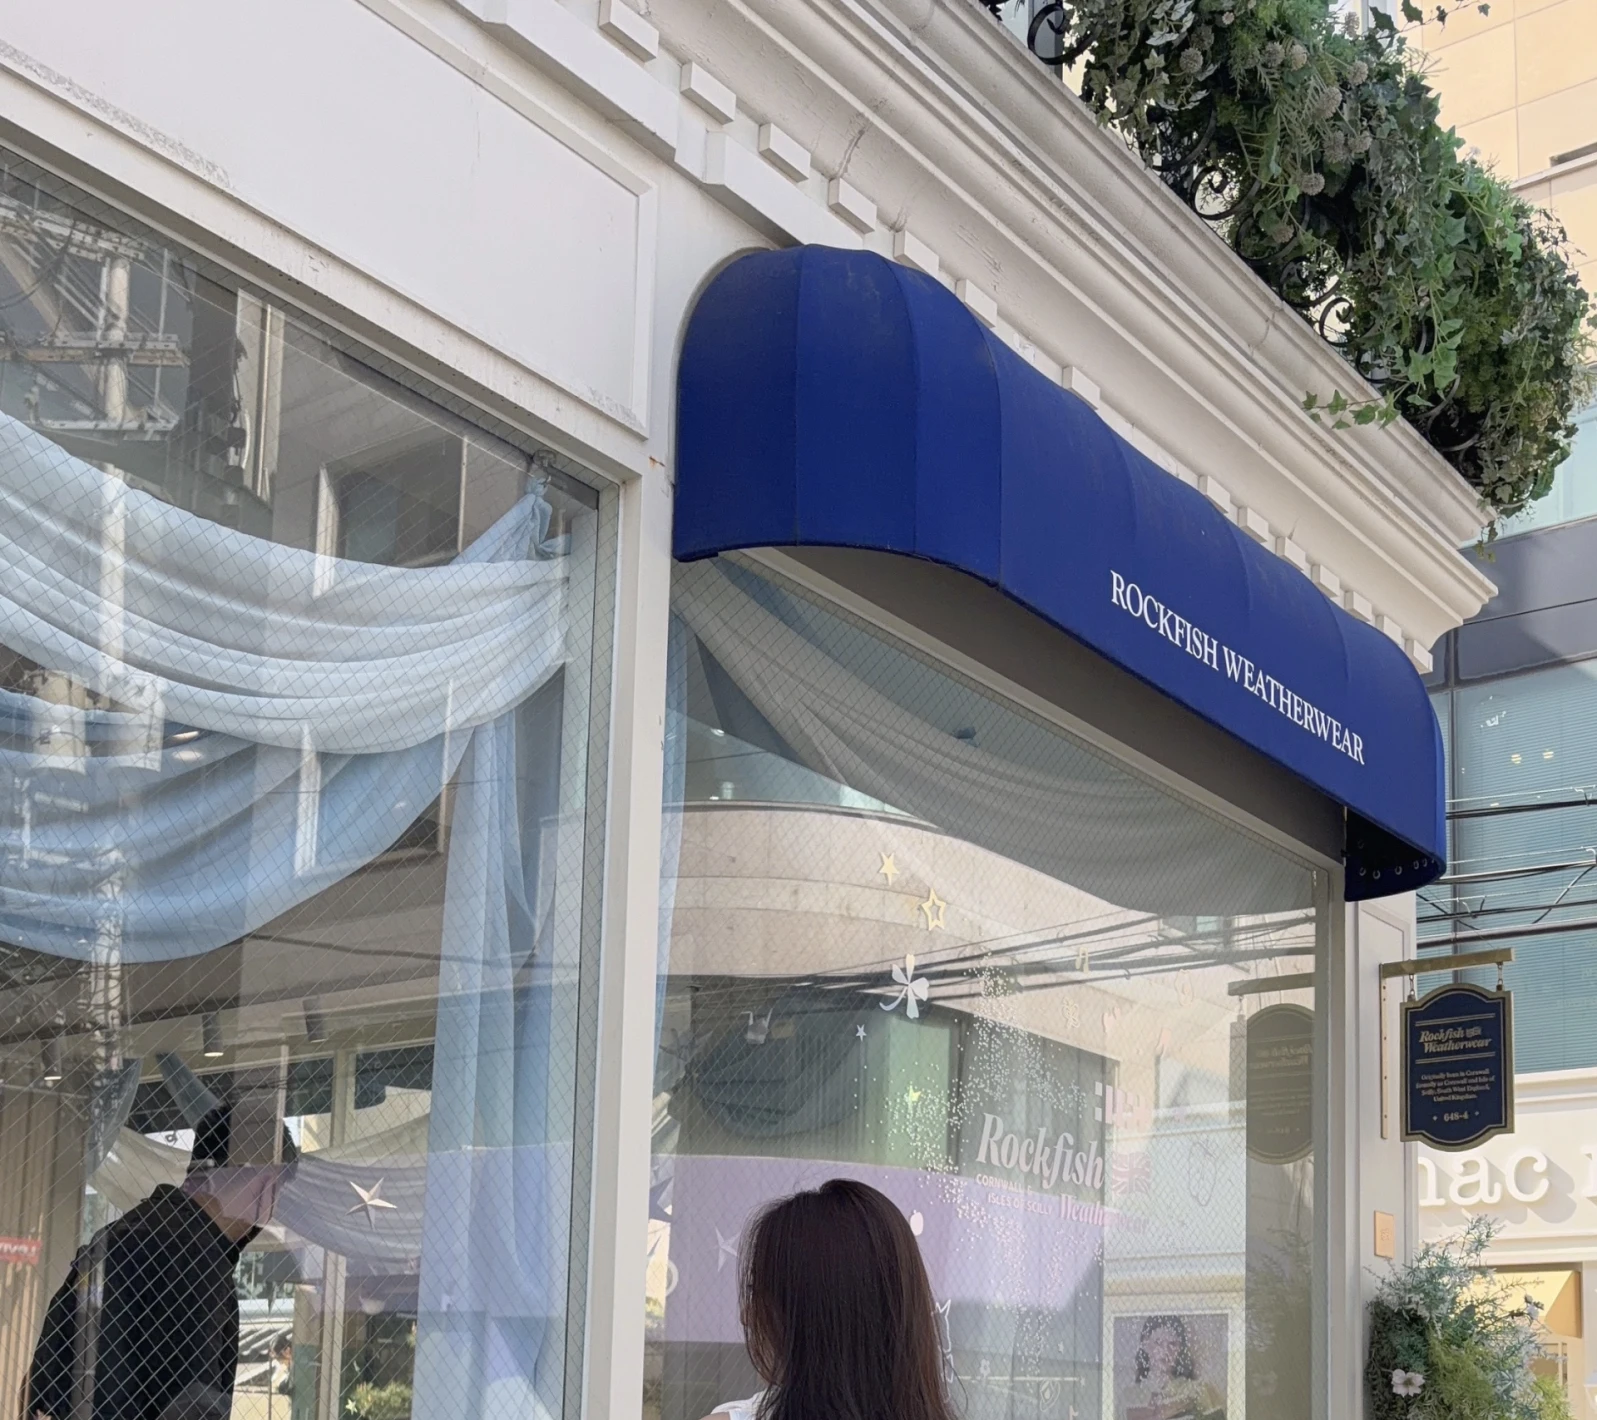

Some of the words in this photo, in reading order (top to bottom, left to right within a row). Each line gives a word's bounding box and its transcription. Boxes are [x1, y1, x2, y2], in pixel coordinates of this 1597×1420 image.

[1110, 570, 1219, 671] ROCKFISH
[1222, 645, 1365, 765] WEATHERWEAR
[1419, 1027, 1465, 1043] Rockfish
[1423, 1038, 1492, 1053] Weatherwear
[1443, 1110, 1469, 1122] 648-4
[975, 1112, 1105, 1190] Rockfish
